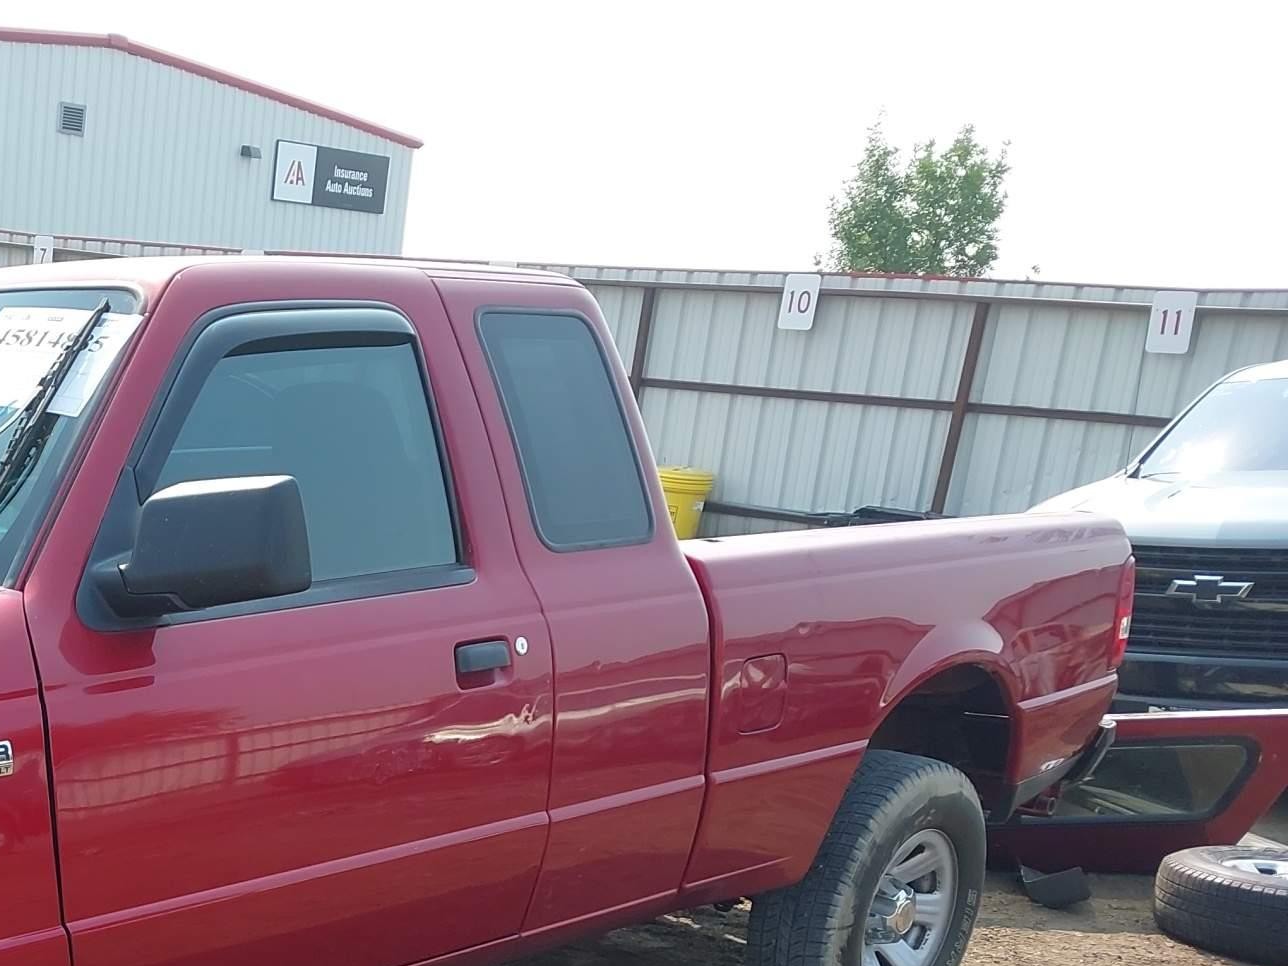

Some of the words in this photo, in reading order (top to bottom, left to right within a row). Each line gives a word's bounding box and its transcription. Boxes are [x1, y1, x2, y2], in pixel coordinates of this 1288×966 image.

[334, 164, 368, 182] Insurance
[325, 179, 342, 193] Auto
[343, 181, 374, 198] Auctions
[40, 247, 47, 262] 7
[787, 290, 811, 314] 10
[1160, 309, 1182, 335] 11
